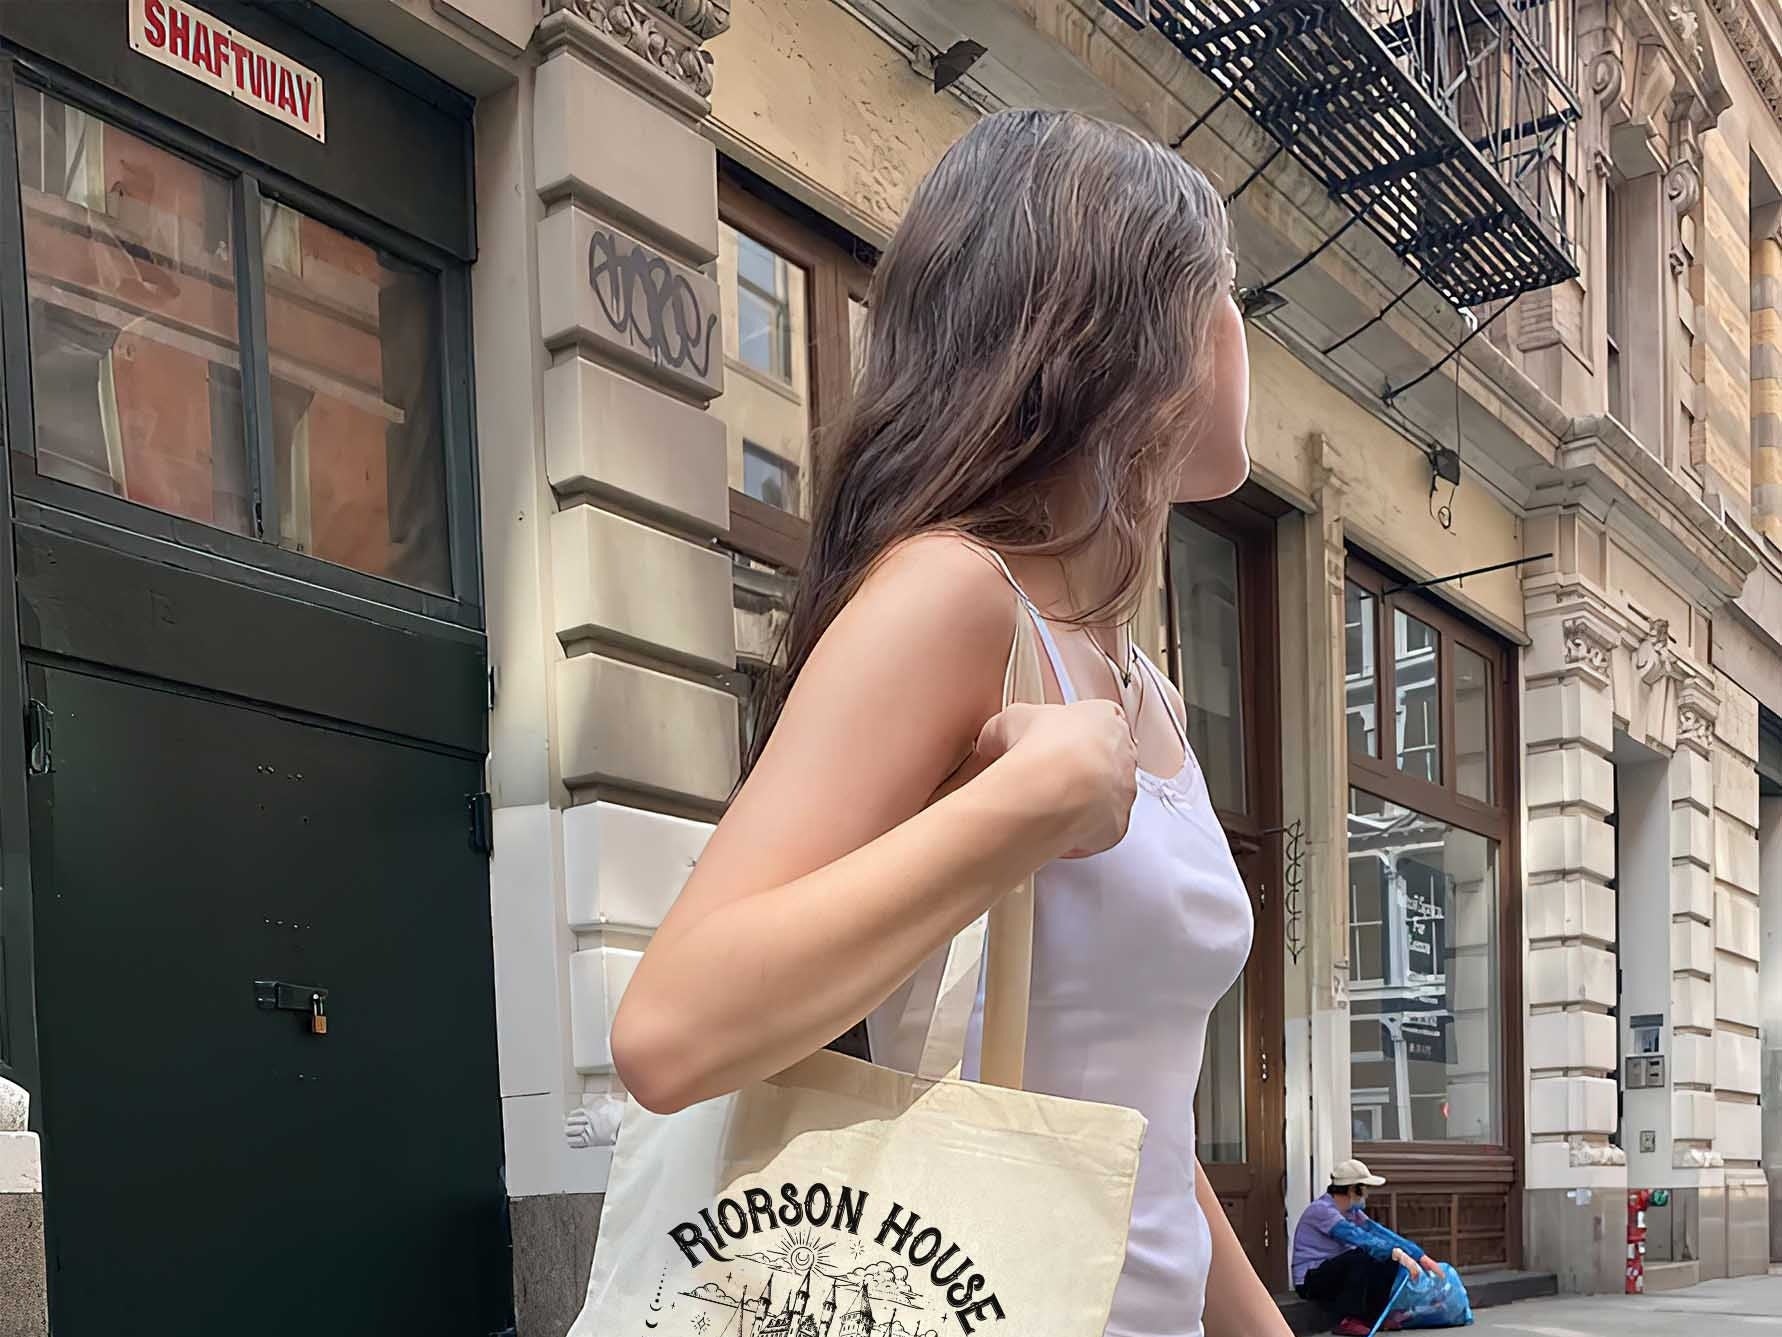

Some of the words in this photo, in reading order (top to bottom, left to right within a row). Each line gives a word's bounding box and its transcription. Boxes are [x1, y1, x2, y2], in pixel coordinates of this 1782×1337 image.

[143, 0, 313, 123] SHAFTWAY
[667, 1182, 869, 1268] RIORSON
[874, 1202, 1006, 1337] HOUSE
